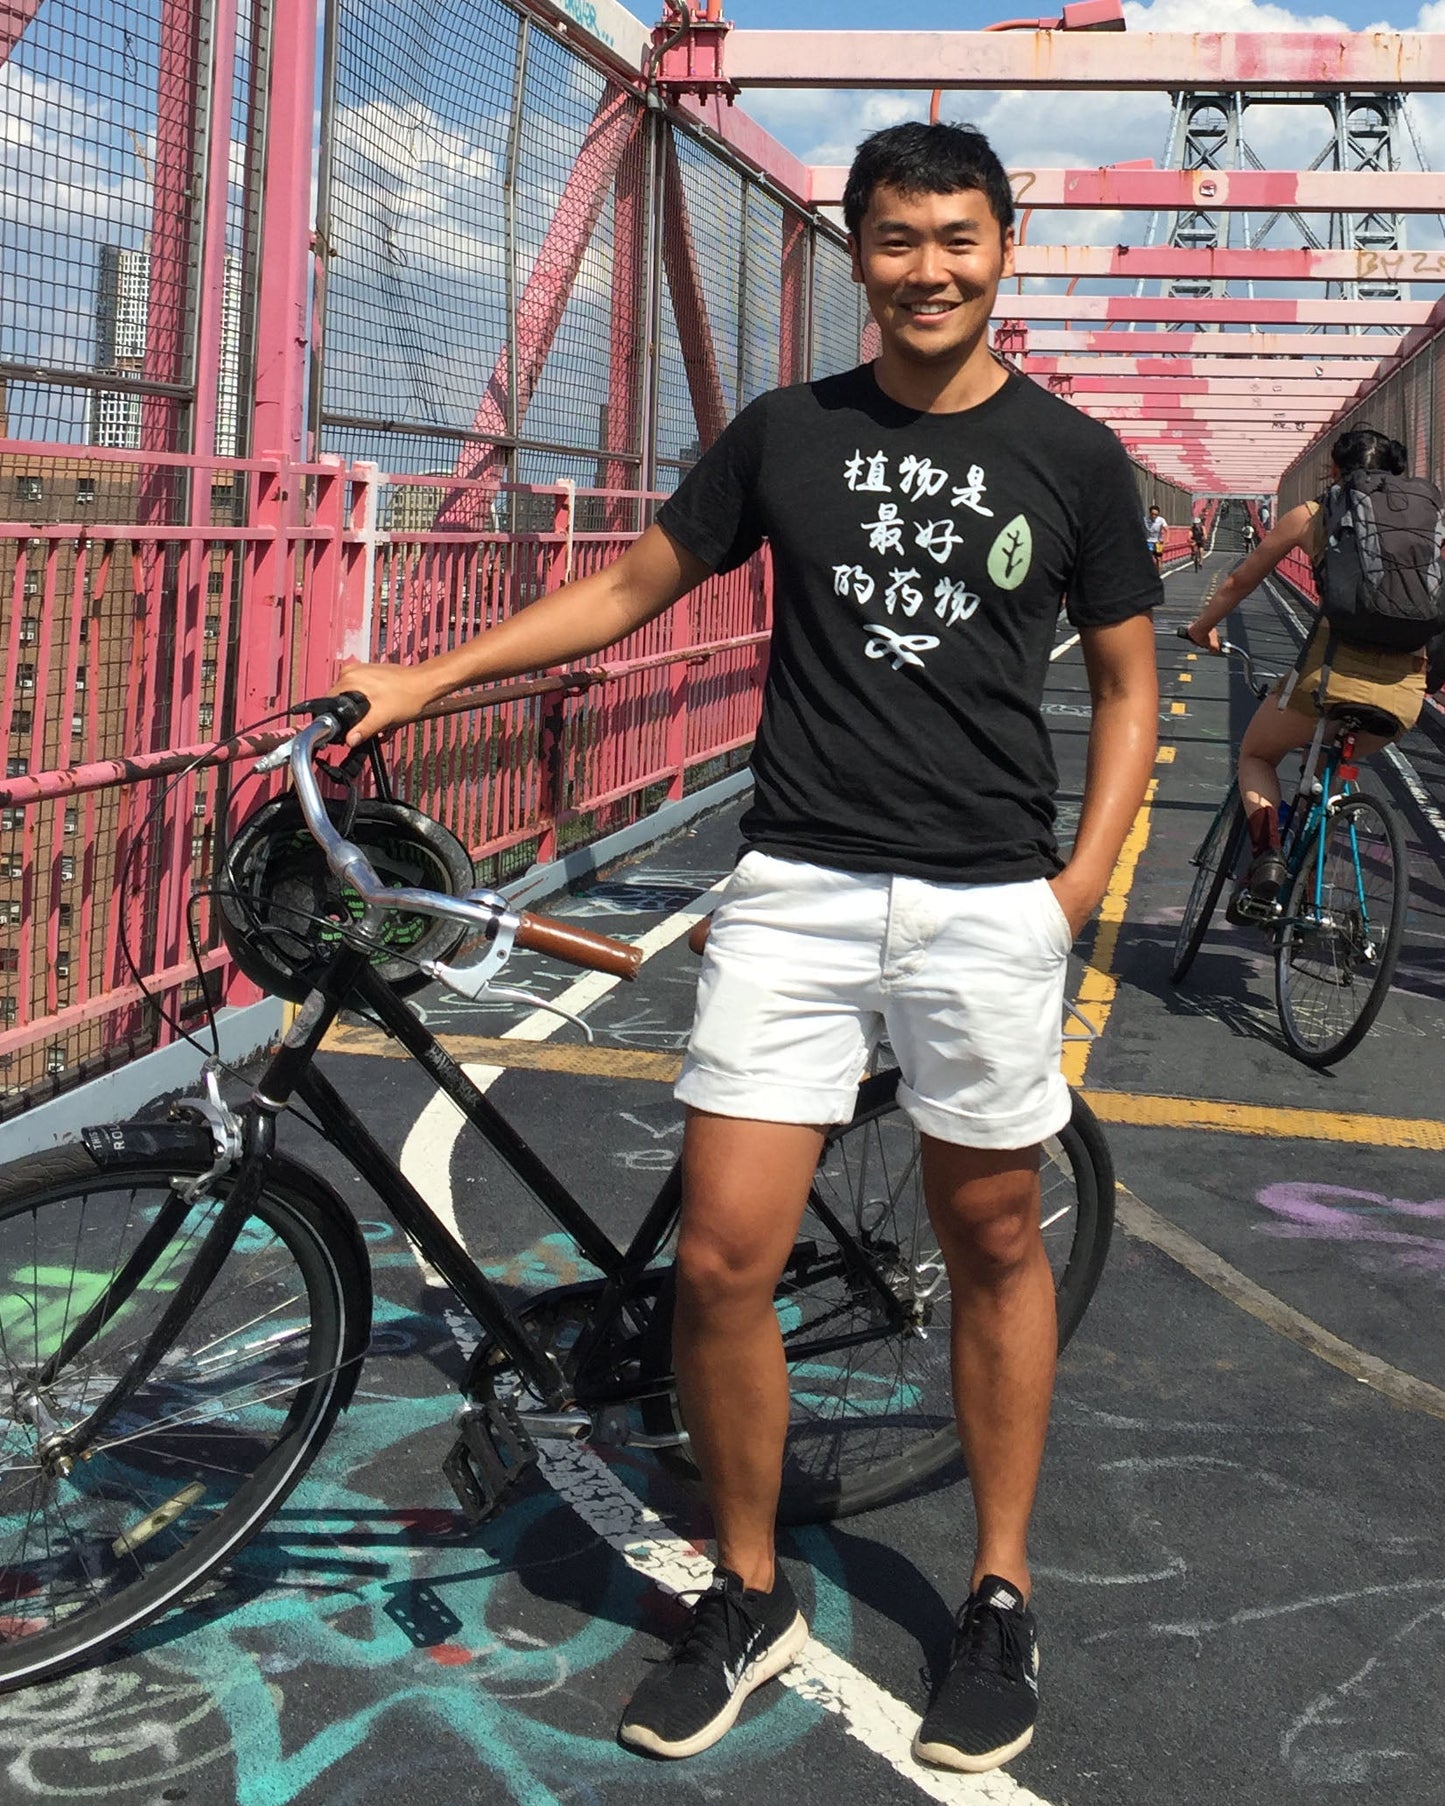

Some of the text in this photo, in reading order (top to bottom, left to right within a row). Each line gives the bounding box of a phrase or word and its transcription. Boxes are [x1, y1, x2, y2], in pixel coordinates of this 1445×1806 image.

[843, 449, 994, 517] 植物是
[860, 503, 964, 564] 最好
[832, 564, 981, 627] 的药物
[88, 1131, 103, 1151] THIS
